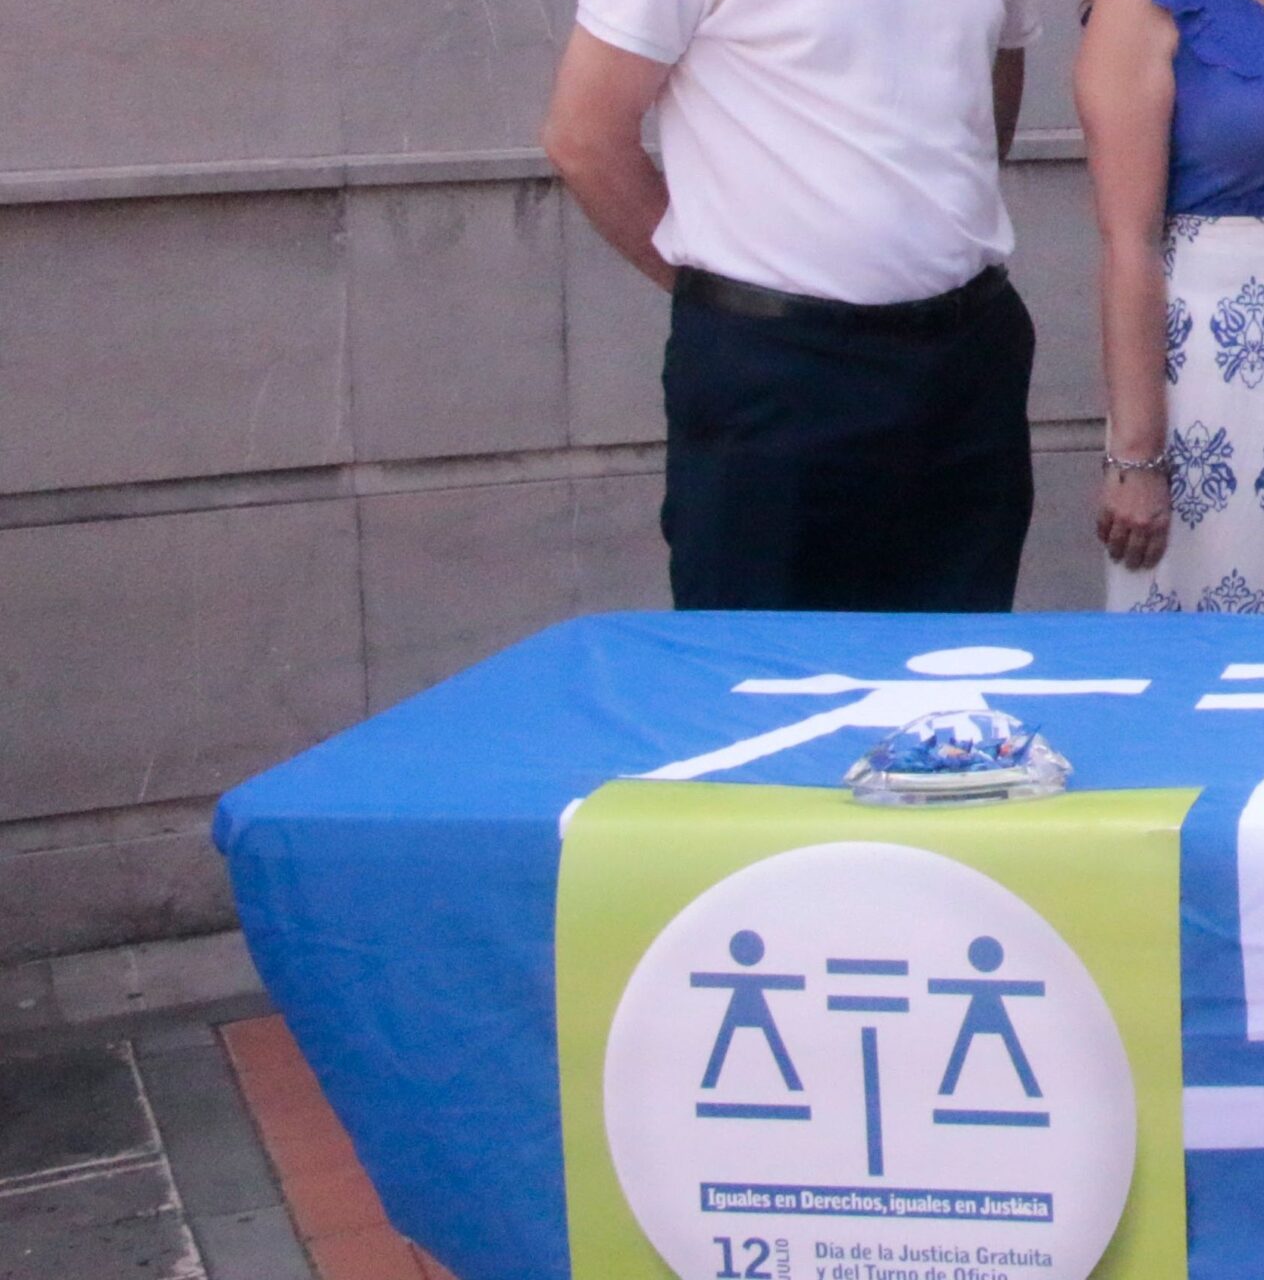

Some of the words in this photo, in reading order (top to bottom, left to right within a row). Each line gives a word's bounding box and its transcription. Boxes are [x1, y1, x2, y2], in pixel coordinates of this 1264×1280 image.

[707, 1187, 771, 1209] Iguales
[775, 1194, 796, 1208] en
[801, 1190, 888, 1214] Derechos,
[890, 1193, 950, 1215] iguales
[955, 1199, 976, 1214] en
[980, 1196, 1048, 1217] Justicia
[713, 1236, 772, 1280] 12
[815, 1241, 845, 1259] Día
[851, 1243, 872, 1261] de
[878, 1243, 893, 1261] la
[899, 1244, 970, 1264] Justicia
[976, 1246, 1052, 1267] Gratuita
[816, 1266, 826, 1280] y
[832, 1263, 860, 1280] del
[863, 1264, 918, 1280] Turno
[925, 1266, 946, 1280] de
[954, 1266, 1008, 1280] Oficio
